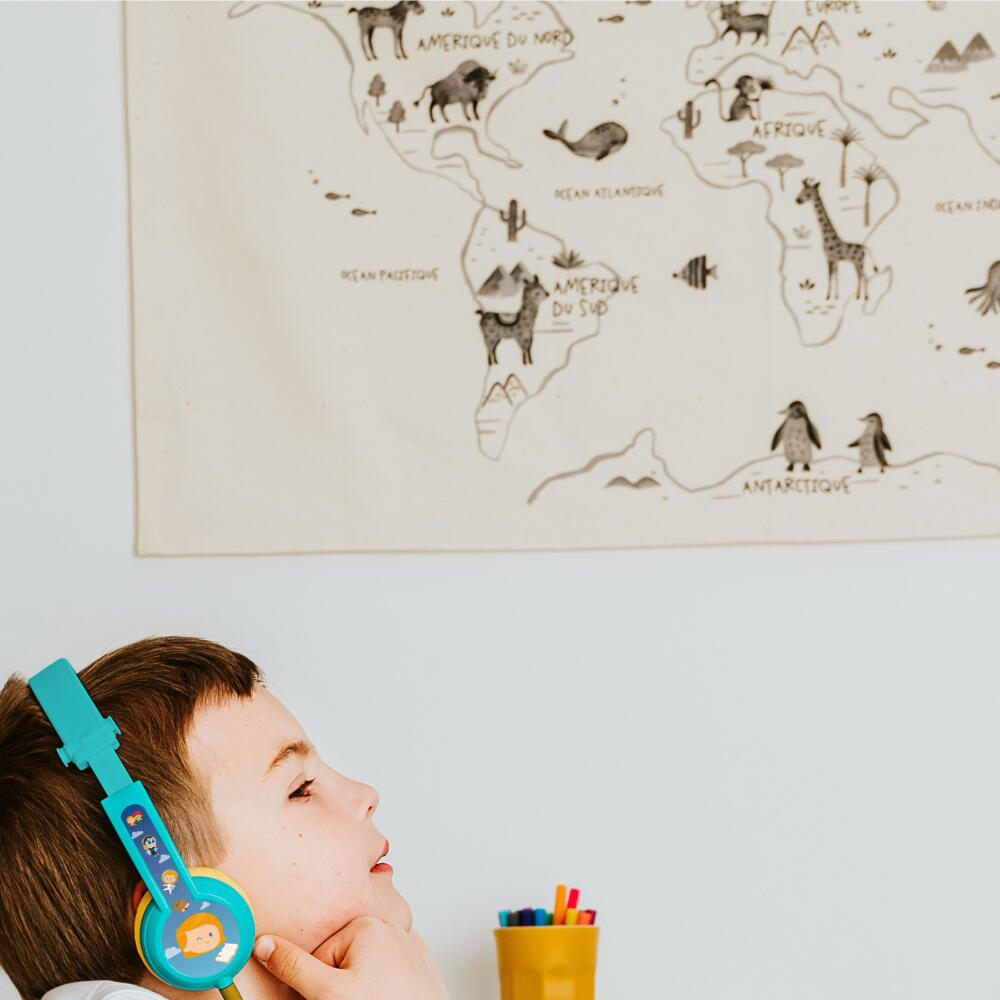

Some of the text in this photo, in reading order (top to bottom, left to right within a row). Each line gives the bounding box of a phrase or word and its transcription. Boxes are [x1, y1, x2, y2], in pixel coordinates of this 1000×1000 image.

[507, 32, 527, 48] DU
[533, 29, 574, 47] NORD
[752, 119, 826, 139] AFRIQUE
[553, 298, 608, 317] DU SUD
[743, 475, 851, 495] ANTARCTIQUE
